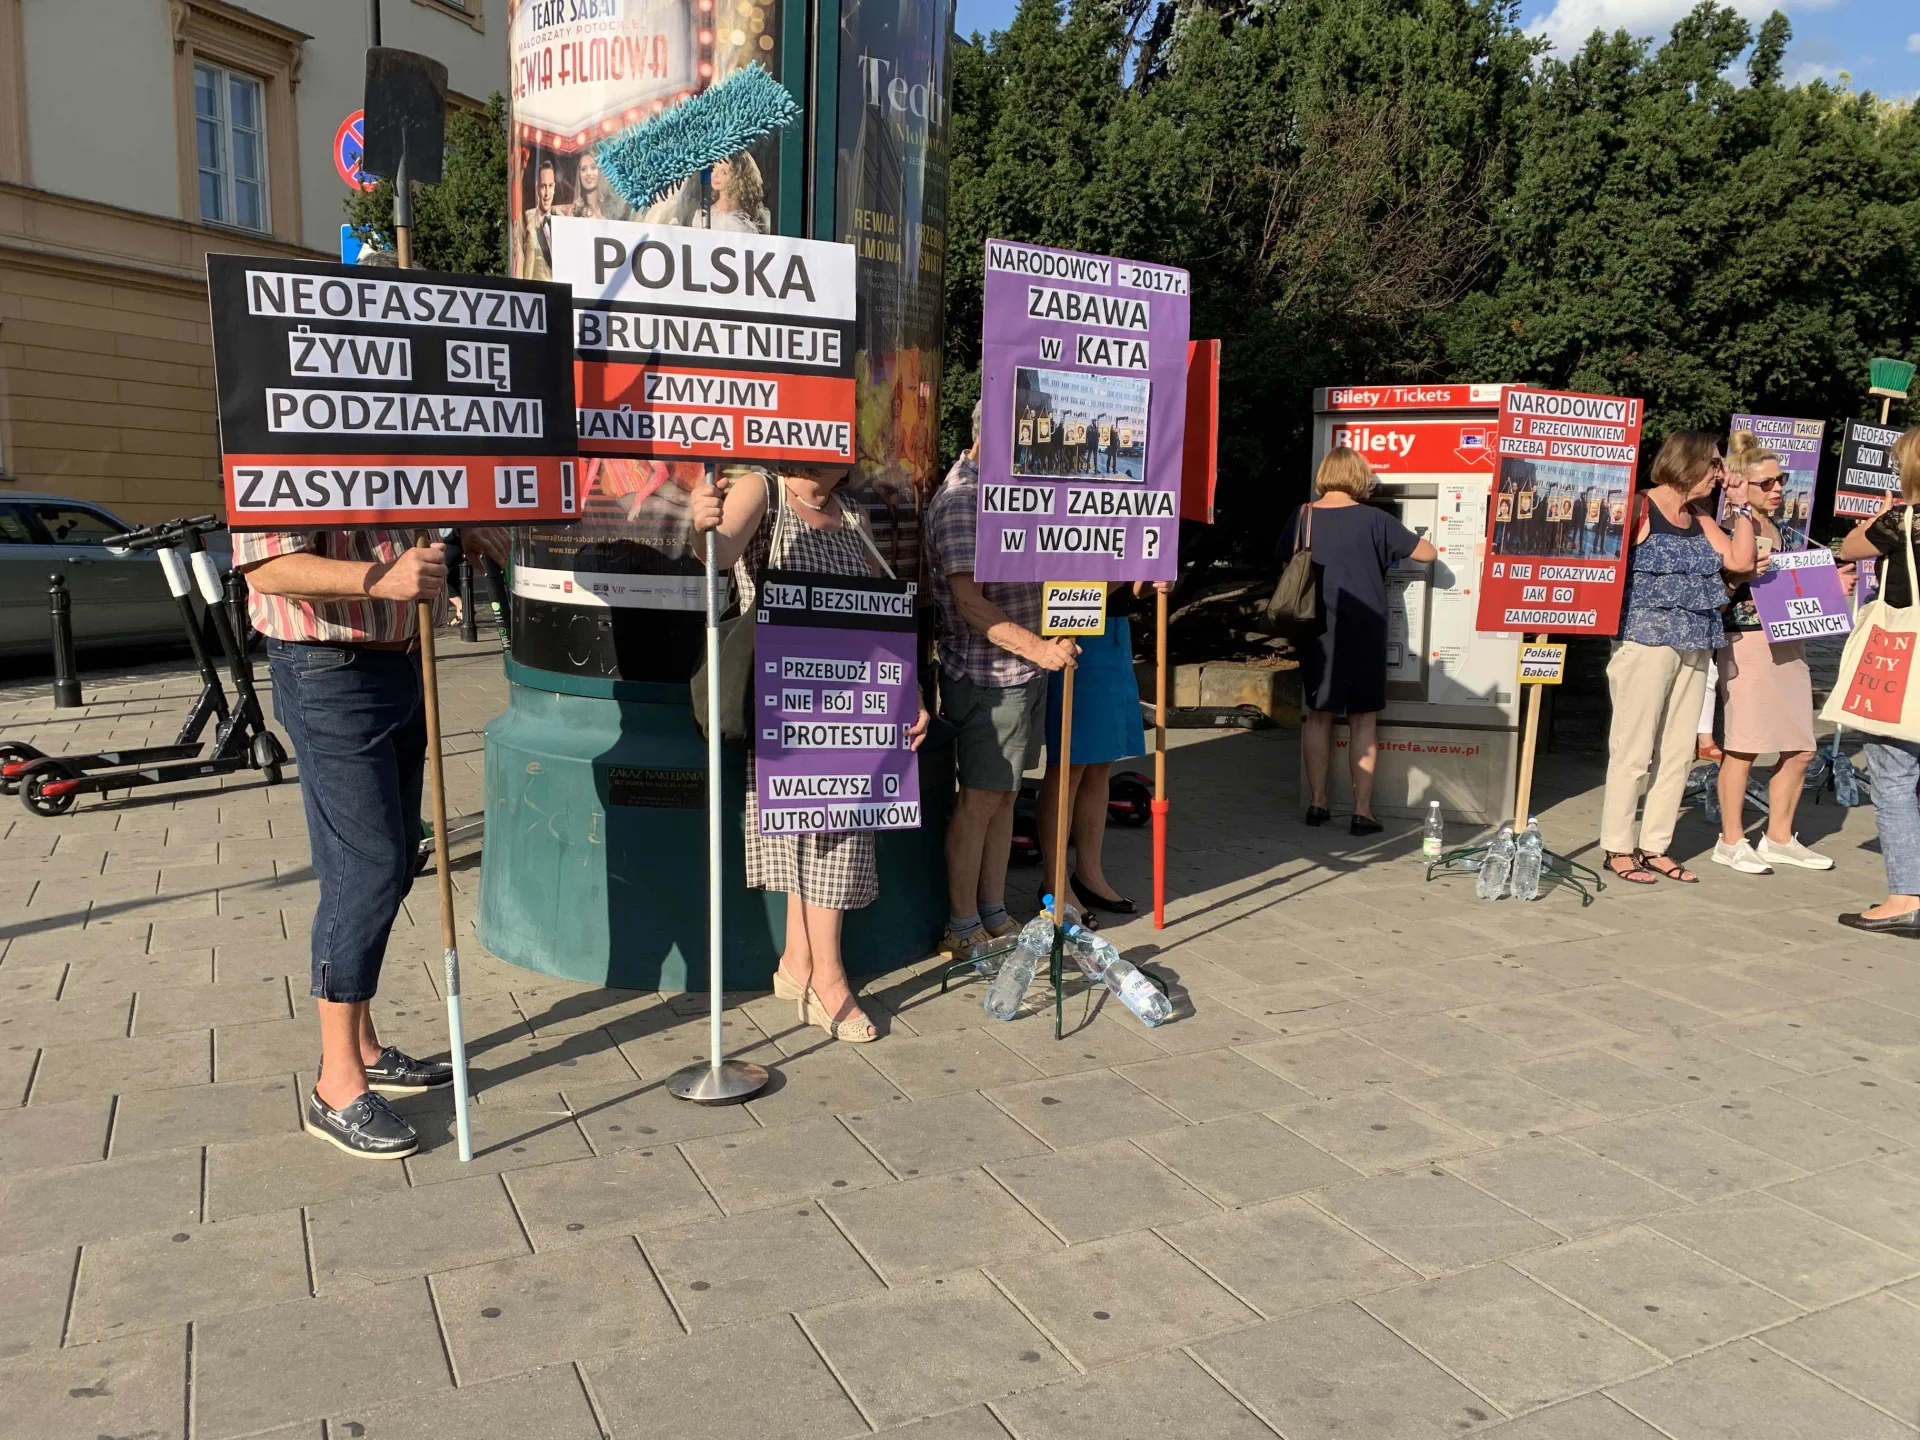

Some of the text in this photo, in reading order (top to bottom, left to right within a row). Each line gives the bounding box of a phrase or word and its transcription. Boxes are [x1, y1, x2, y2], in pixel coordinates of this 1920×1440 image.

[532, 0, 565, 31] TEATR
[558, 33, 668, 87] FILMOWA
[854, 208, 895, 235] REWIA
[593, 236, 817, 303] POLSKA
[989, 245, 1111, 284] NARODOWCY
[252, 274, 545, 331] NEOFASZYZM
[1028, 287, 1148, 330] ZABAWA
[578, 313, 840, 364] BRUNATNIEJE
[1077, 334, 1148, 370] KATA
[292, 326, 508, 391] ŻYWI SIĘ
[646, 374, 777, 408] ZMYJMY
[1332, 389, 1381, 407] Bilety
[1393, 387, 1451, 403] Tickets
[272, 392, 541, 434] PODZIAŁAMI
[1509, 393, 1626, 421] NARODOWCY
[576, 405, 849, 455] HAŃBIĄCĄ BARWĘ
[1530, 421, 1625, 441] PRZECIWNIKIEM
[1736, 419, 1821, 435] NIE CHCEMY TAKIEJ
[1335, 427, 1416, 458] Bilety
[1501, 438, 1545, 455] TRZEBA
[1551, 442, 1635, 461] DYSKUTOWAĆ
[1758, 437, 1817, 452] RYSTIANIZACJI
[1857, 444, 1883, 465] ŻYWI
[236, 468, 464, 508] ZASYPMY
[498, 469, 536, 504] JE
[983, 485, 1175, 517] KIEDY ZABAWA
[1038, 527, 1126, 558] WOJNĘ
[1493, 564, 1616, 582] A NIE POKAZYWAĆ
[1048, 587, 1102, 603] Polskie
[1523, 588, 1573, 601] JAK GO
[1048, 615, 1099, 628] Babcie
[1505, 610, 1596, 625] ZAMORDOWAĆ
[1523, 647, 1563, 659] Polskie
[784, 661, 868, 681] PRZEBUDŹ
[879, 663, 901, 684] SIĘ
[1522, 667, 1559, 678] Babcie
[785, 693, 812, 710] NIE
[824, 690, 853, 711] BÓJ
[864, 692, 886, 713] SIĘ
[784, 724, 896, 746] PROTESTUJ
[610, 768, 705, 781] ZAKAZ NAKLEJANIA
[772, 775, 898, 797] WALCZYSZ O
[762, 802, 918, 831] JUTRO WNUKÓW
